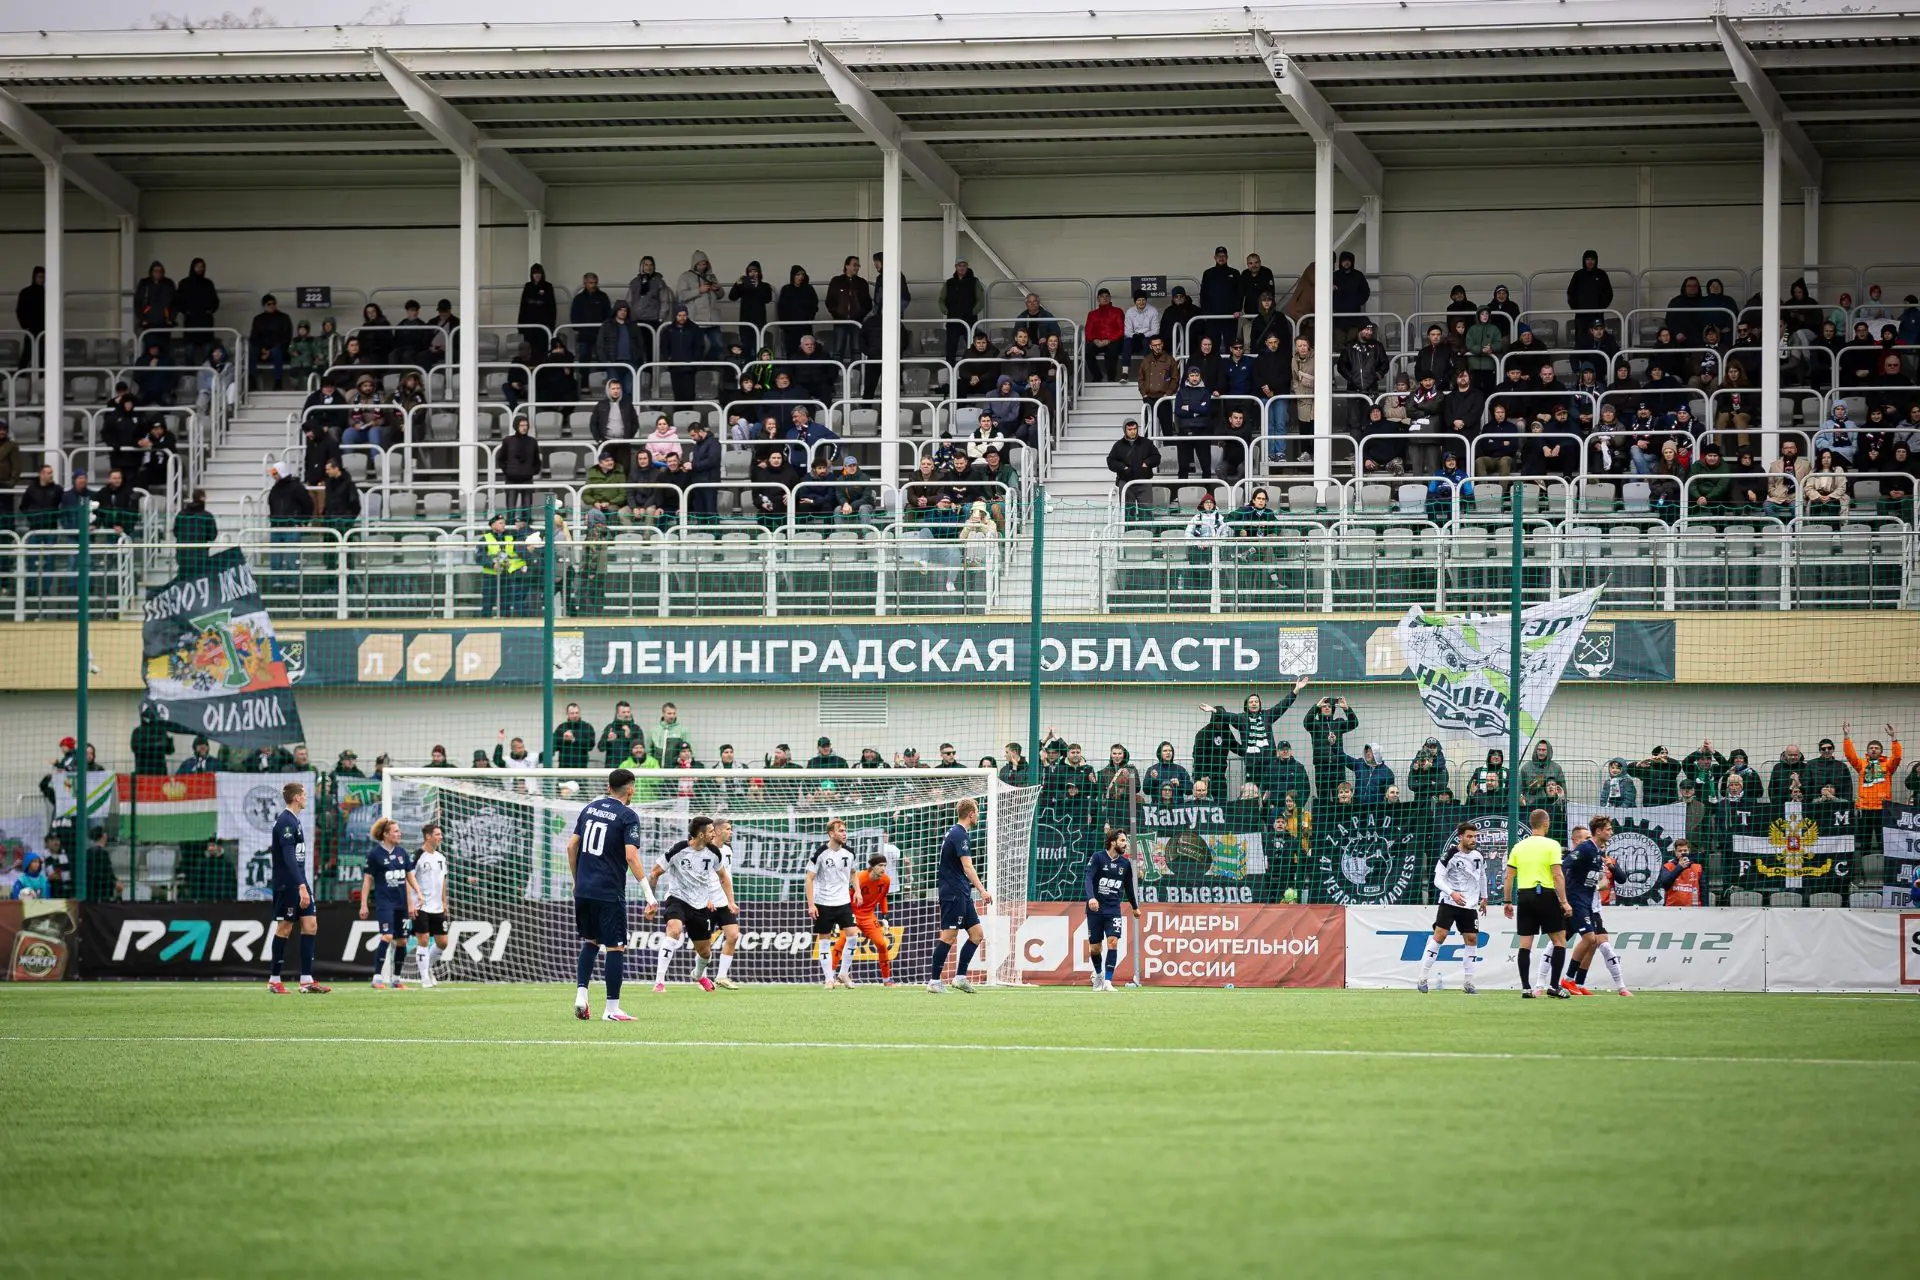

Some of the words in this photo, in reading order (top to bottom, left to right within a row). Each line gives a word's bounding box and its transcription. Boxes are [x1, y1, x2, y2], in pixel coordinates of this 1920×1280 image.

[305, 293, 322, 302] 222
[1140, 283, 1158, 291] 223
[363, 651, 482, 675] ЛСР
[601, 637, 1015, 679] ЛЕНИНГРАДСКАЯ
[1040, 636, 1261, 672] ОБЛАСТЬ
[1142, 805, 1225, 829] Калуга
[582, 819, 608, 857] 10
[1378, 854, 1416, 906] MADNESS
[1166, 886, 1253, 904] выезде
[1144, 911, 1239, 933] ЛИДЕРЫ
[341, 920, 512, 962] PRI
[1144, 934, 1319, 957] СТРОИТЕЛЬНОЙ
[1145, 957, 1235, 979] РОССИИ
